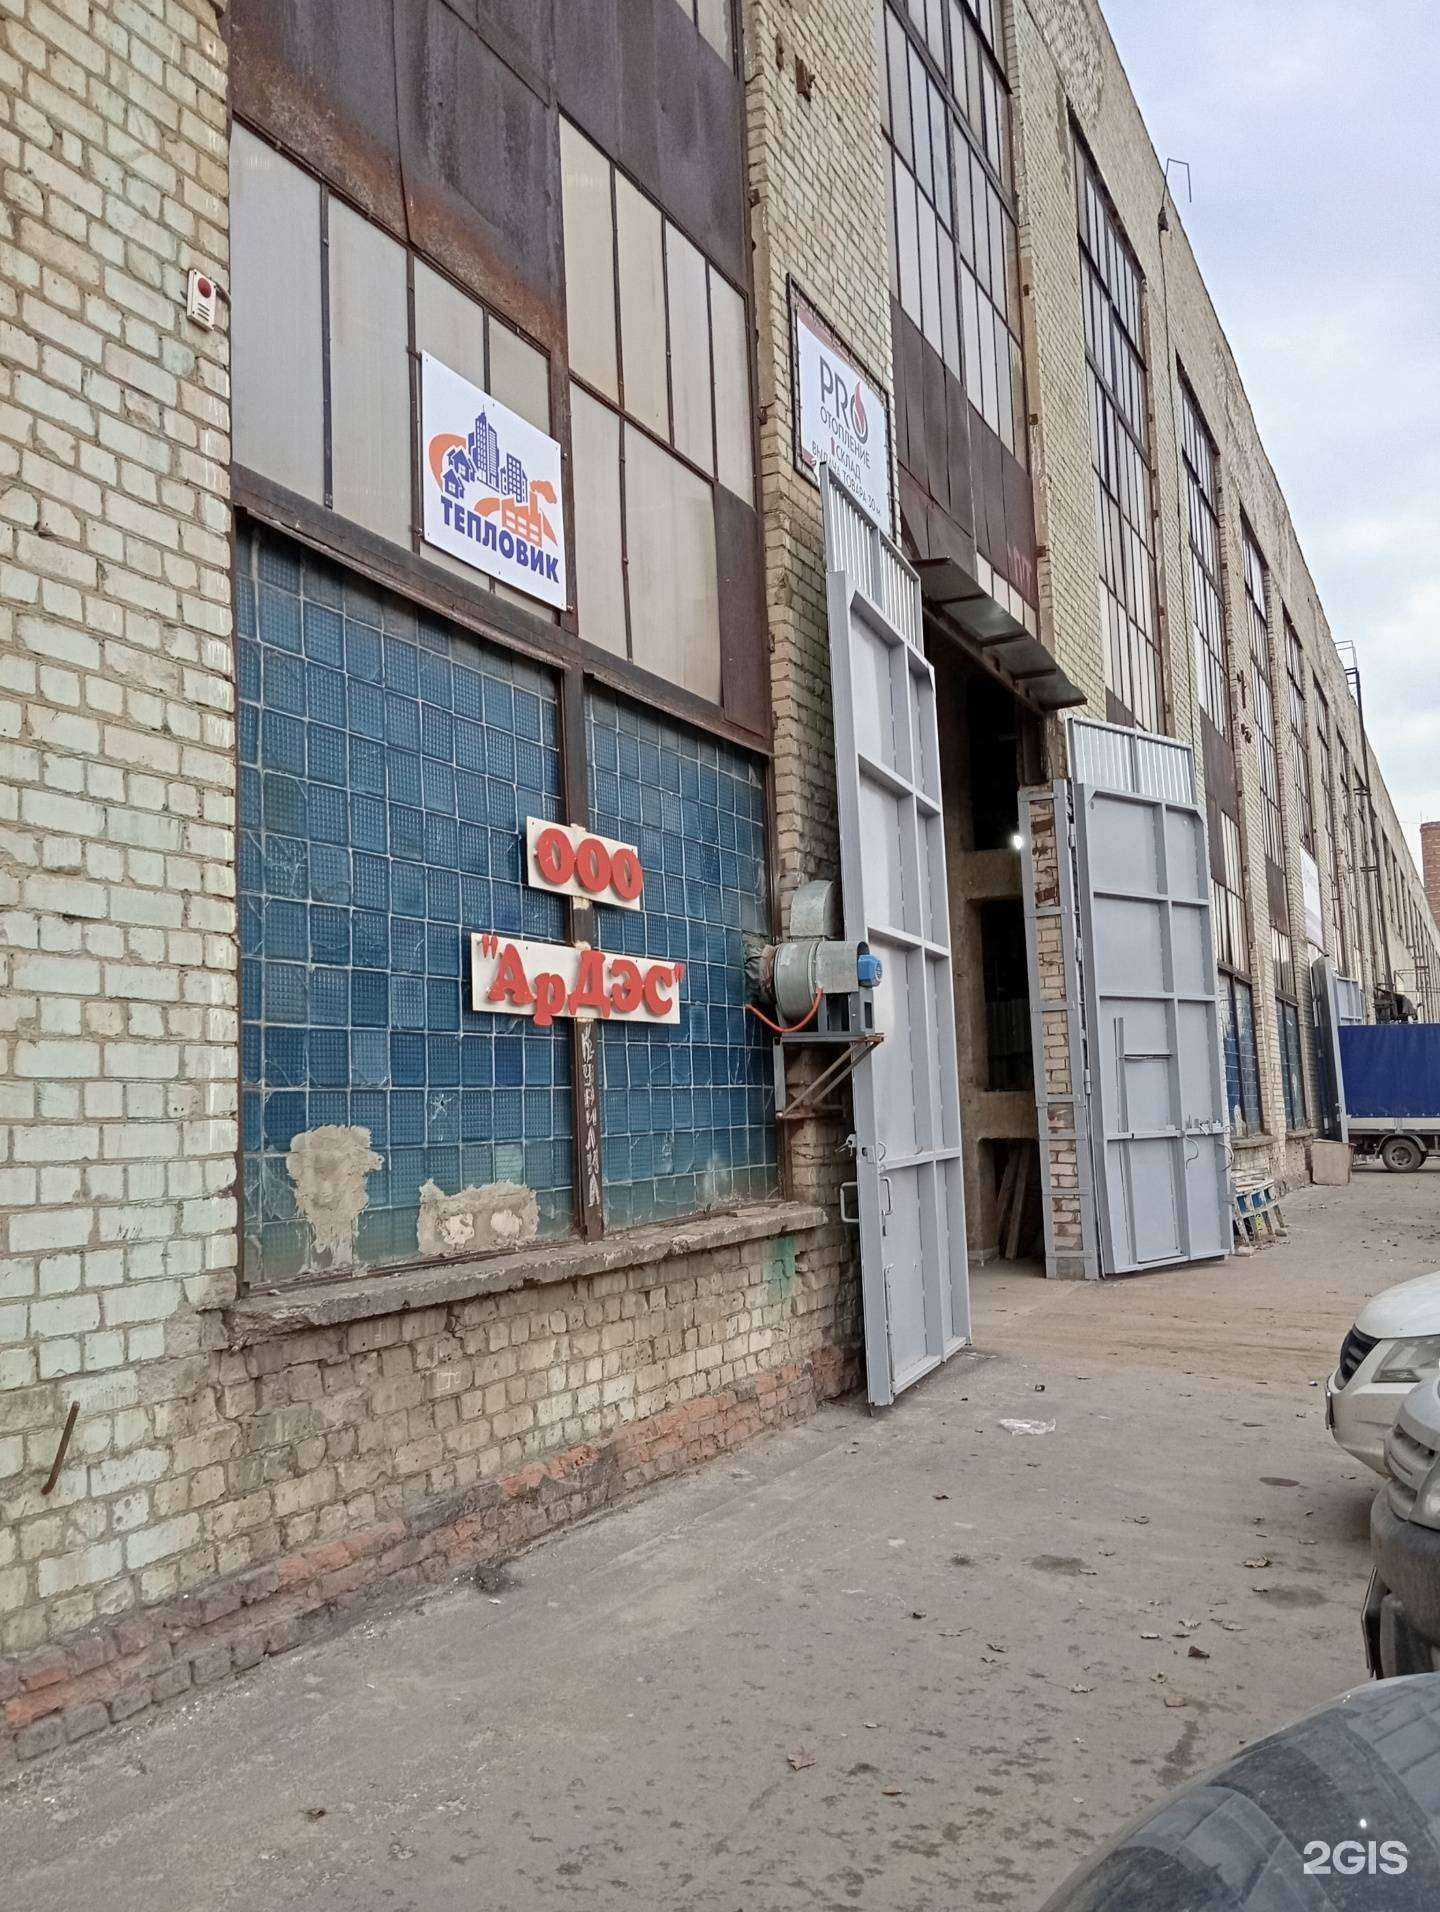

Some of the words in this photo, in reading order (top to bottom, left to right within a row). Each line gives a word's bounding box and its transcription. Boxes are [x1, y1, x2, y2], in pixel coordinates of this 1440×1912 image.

[819, 354, 869, 445] PRO
[819, 405, 871, 470] ОТОПЛЕНИЕ
[836, 444, 861, 483] СКЛАД
[440, 494, 560, 584] ТЕПЛОВИК
[534, 828, 644, 900] ООО
